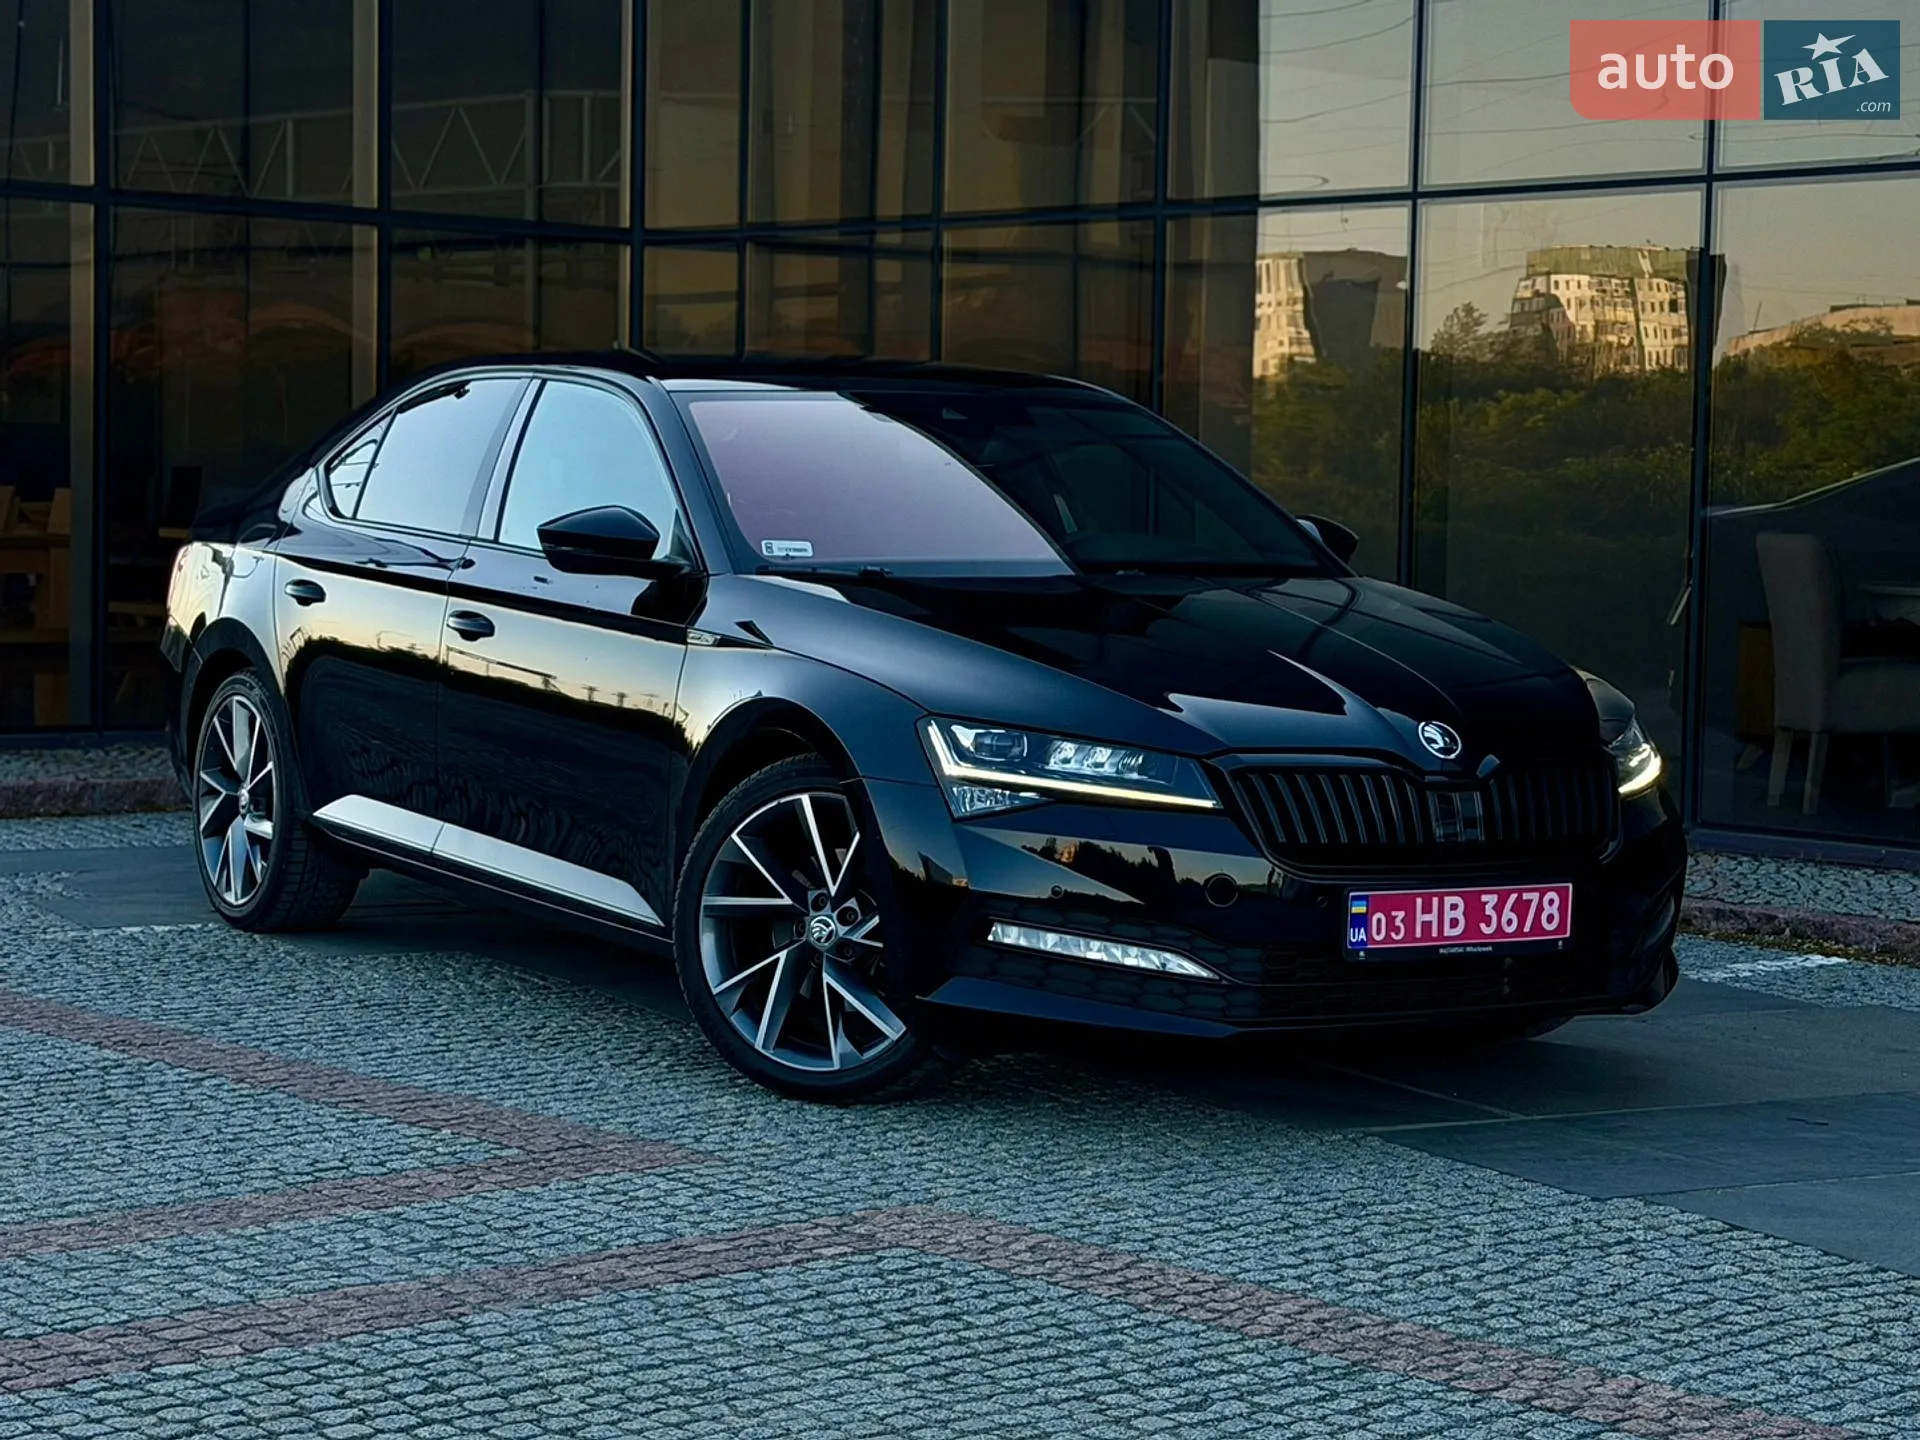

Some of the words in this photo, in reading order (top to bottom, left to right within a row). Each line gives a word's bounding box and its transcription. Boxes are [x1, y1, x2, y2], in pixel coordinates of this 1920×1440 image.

[1371, 911, 1406, 941] 03
[1415, 896, 1465, 938] HB
[1479, 891, 1560, 934] 3678
[1350, 927, 1367, 943] UA
